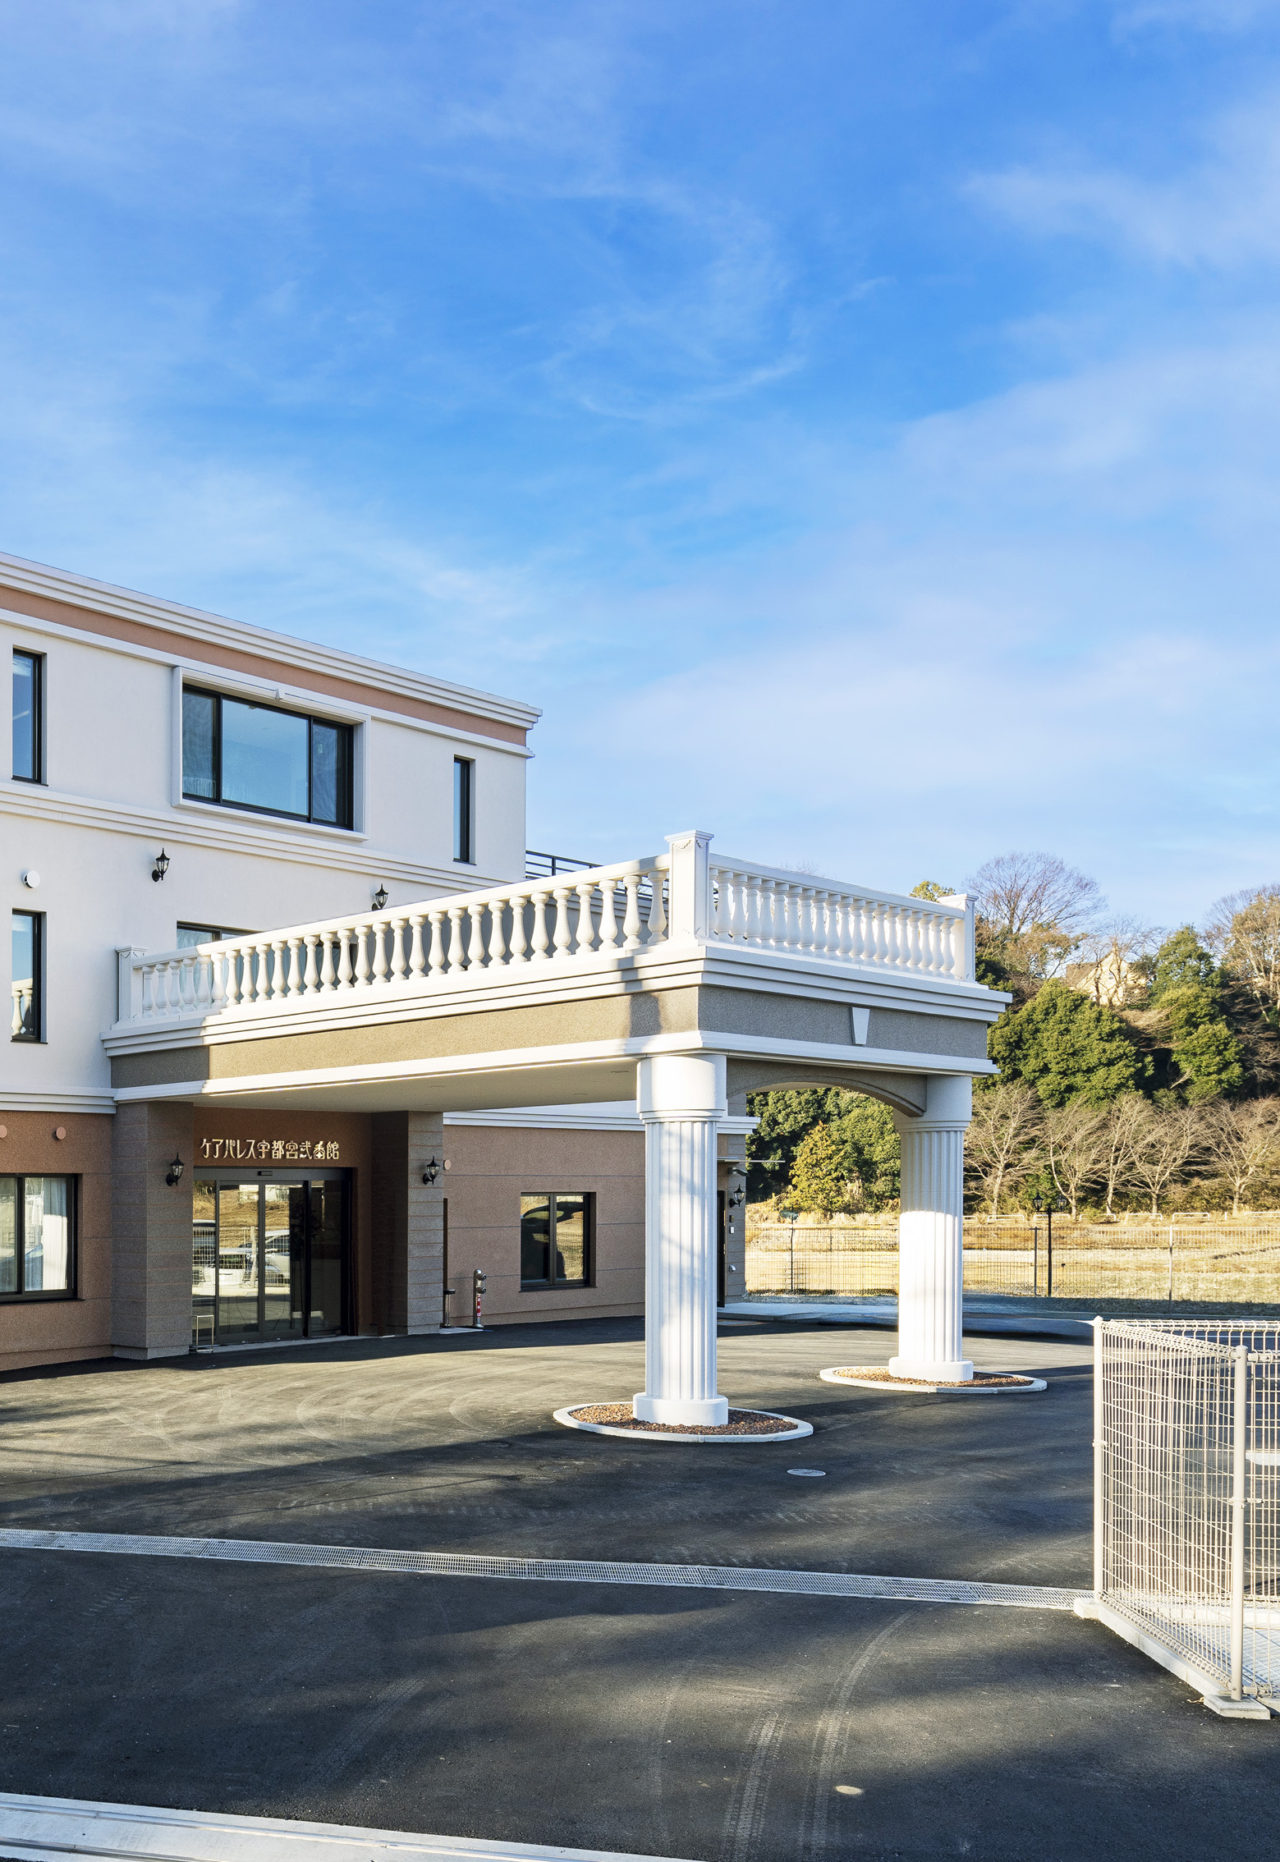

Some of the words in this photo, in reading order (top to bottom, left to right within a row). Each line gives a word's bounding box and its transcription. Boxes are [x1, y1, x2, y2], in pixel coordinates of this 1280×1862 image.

[200, 1138, 340, 1160] ケアパレス宇都宮弐番館
